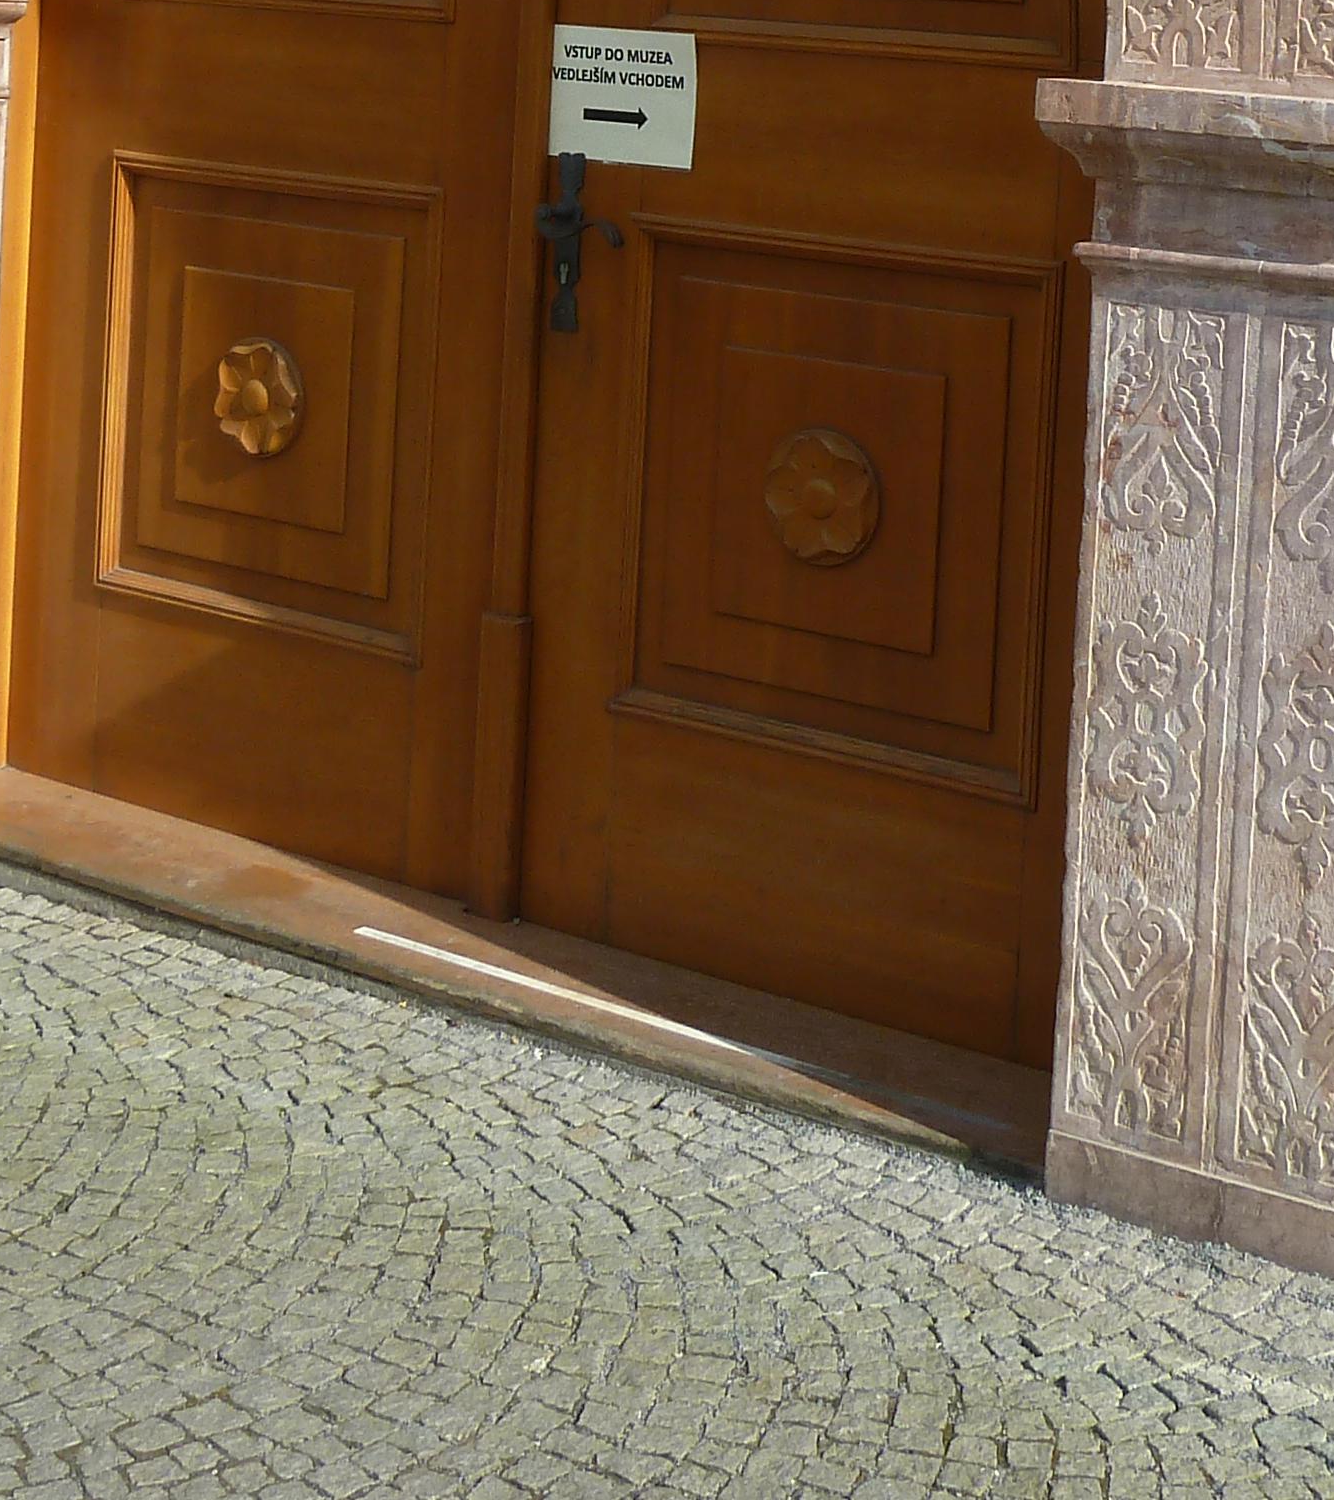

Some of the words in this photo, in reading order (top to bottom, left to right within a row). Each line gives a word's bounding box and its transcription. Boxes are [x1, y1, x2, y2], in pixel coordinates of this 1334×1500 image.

[564, 44, 602, 60] VSTUP
[605, 48, 624, 62] DO
[627, 50, 673, 65] MUZEA
[553, 66, 616, 84] VEDLEJŠÍM
[619, 71, 685, 90] VCHODEM
